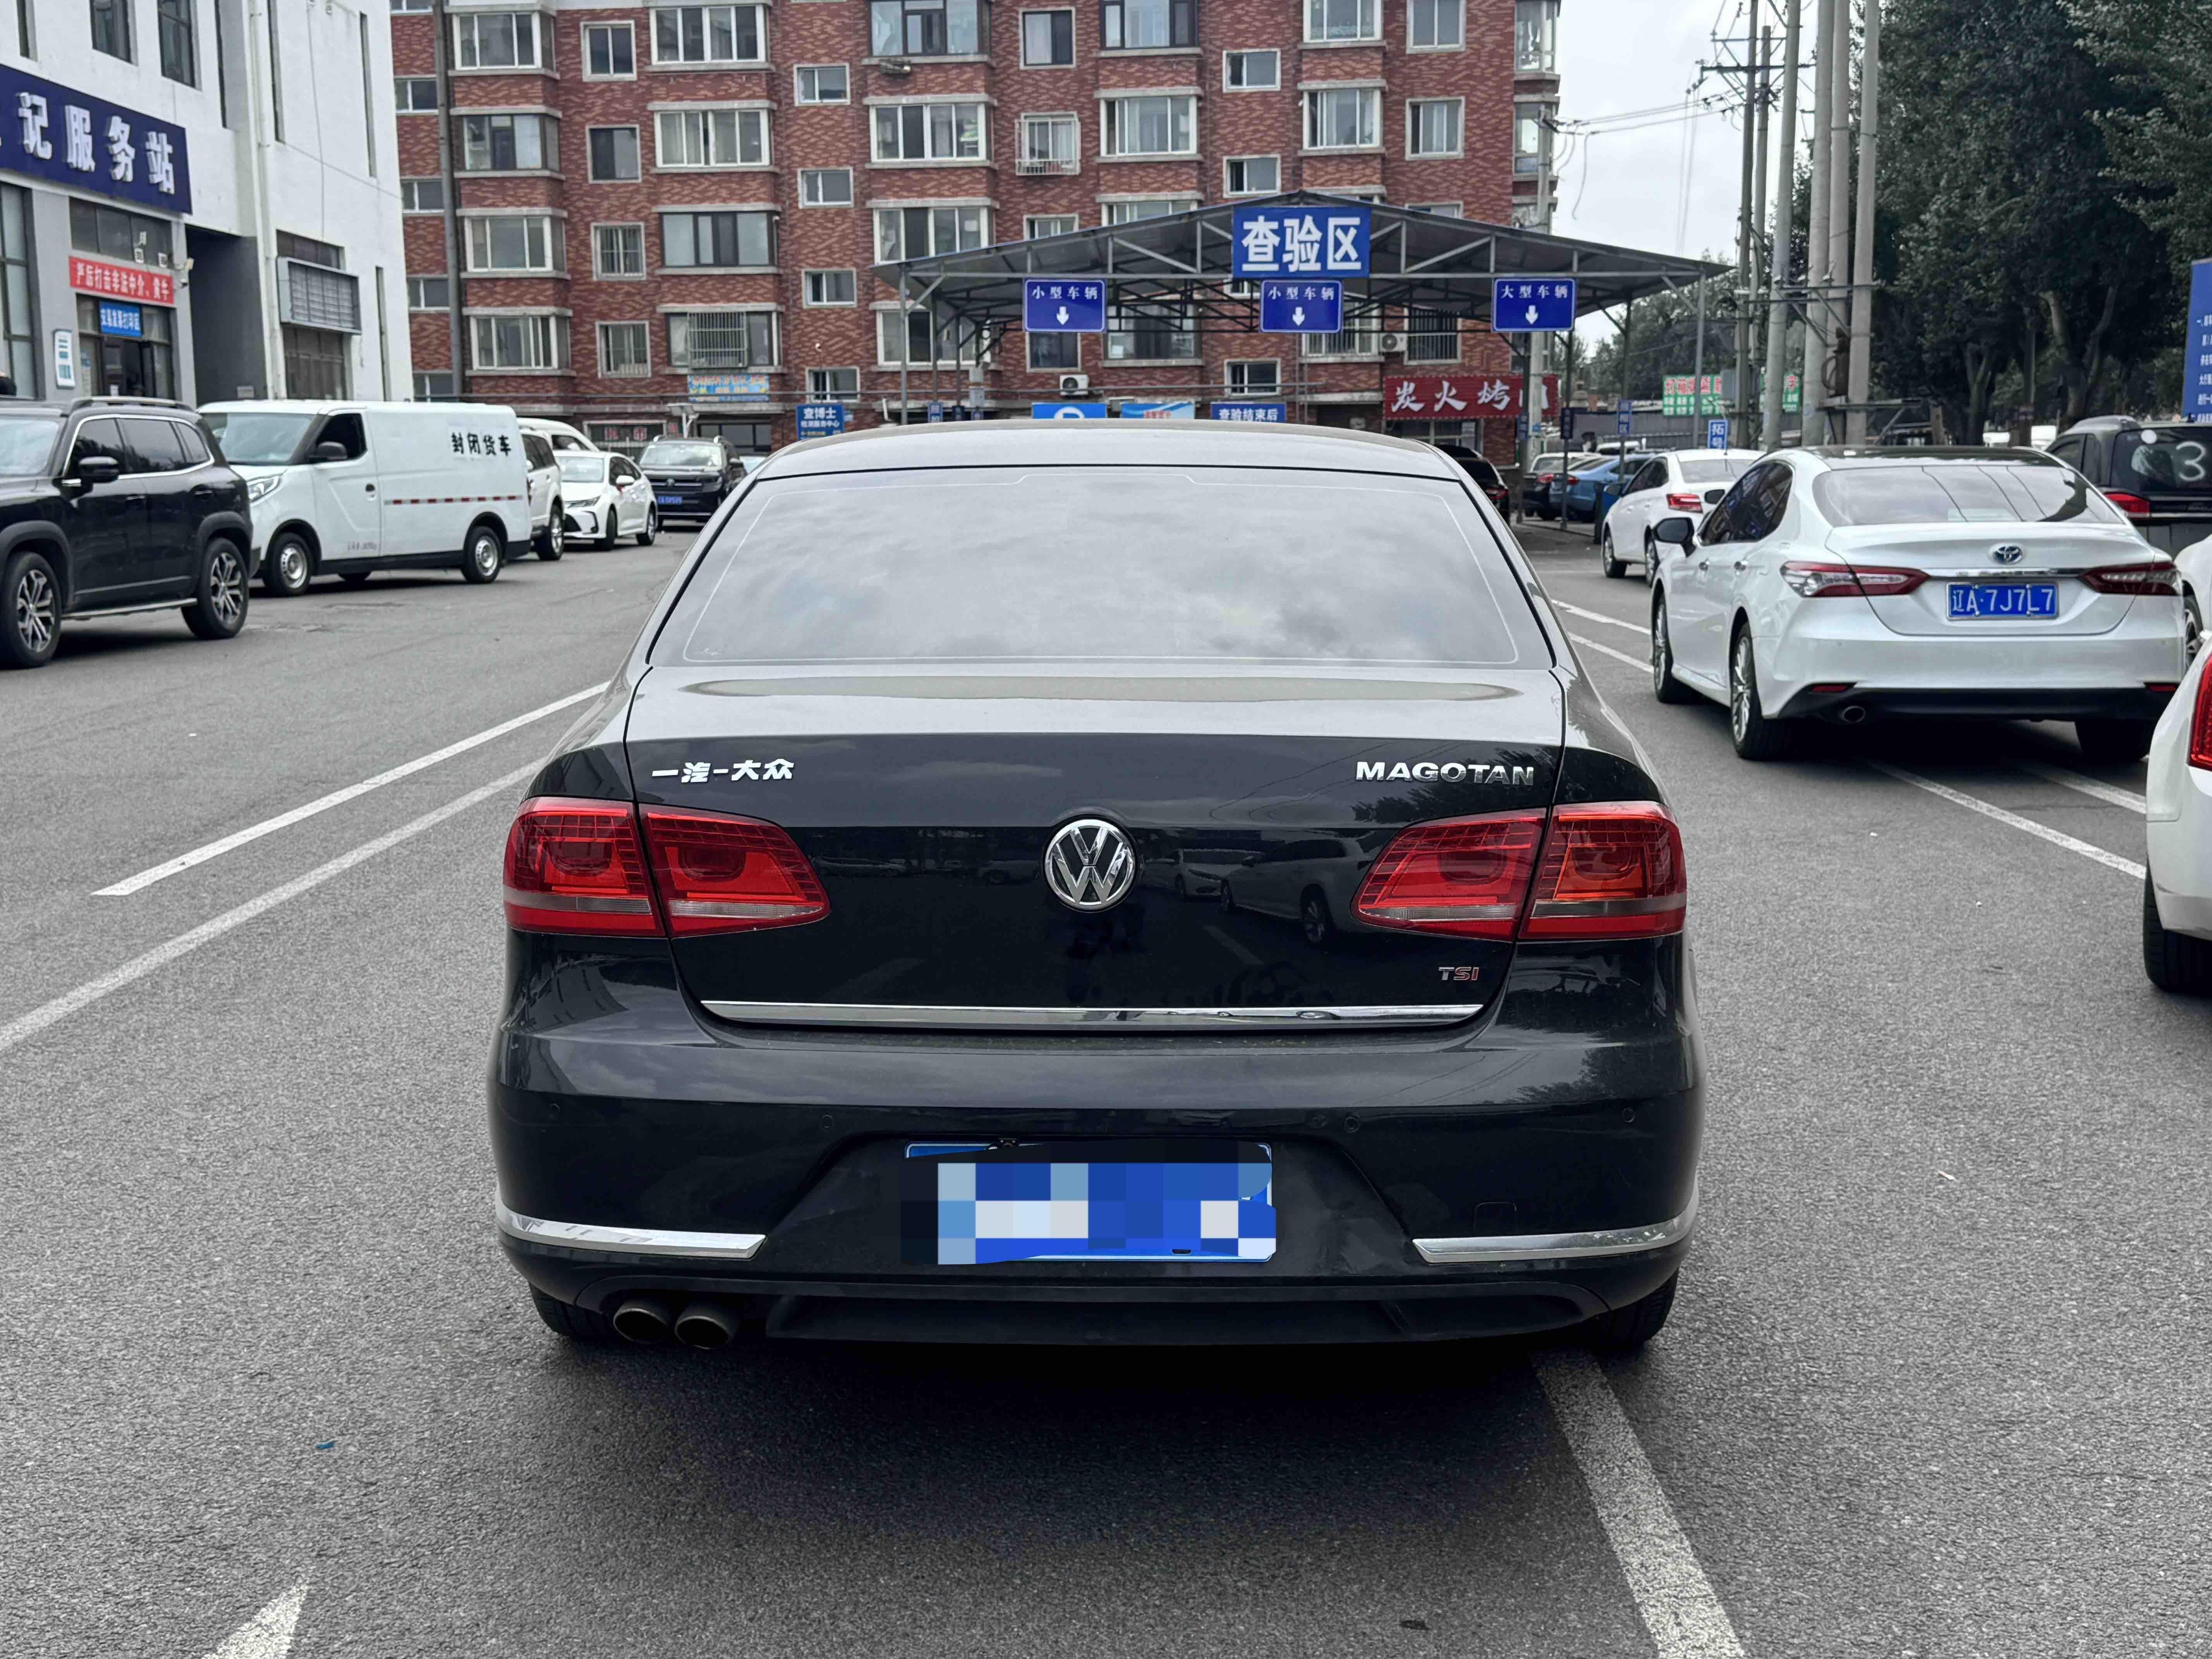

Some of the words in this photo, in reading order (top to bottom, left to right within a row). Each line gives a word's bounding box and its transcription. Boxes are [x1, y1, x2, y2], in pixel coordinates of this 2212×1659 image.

[0, 92, 175, 195] 记服务站
[1241, 214, 1362, 273] 查验区
[1031, 285, 1098, 300] 小型车辆
[1267, 286, 1334, 301] 小型车辆
[1500, 284, 1568, 299] 大型车辆
[803, 407, 837, 419] 查博士
[1219, 407, 1278, 422] 查验结束后
[451, 432, 511, 457] 封闭货车
[2175, 441, 2206, 481] 3
[652, 758, 795, 783] 一汽-大众
[1355, 761, 1534, 786] MAGOTAN
[1438, 967, 1479, 981] TSI
